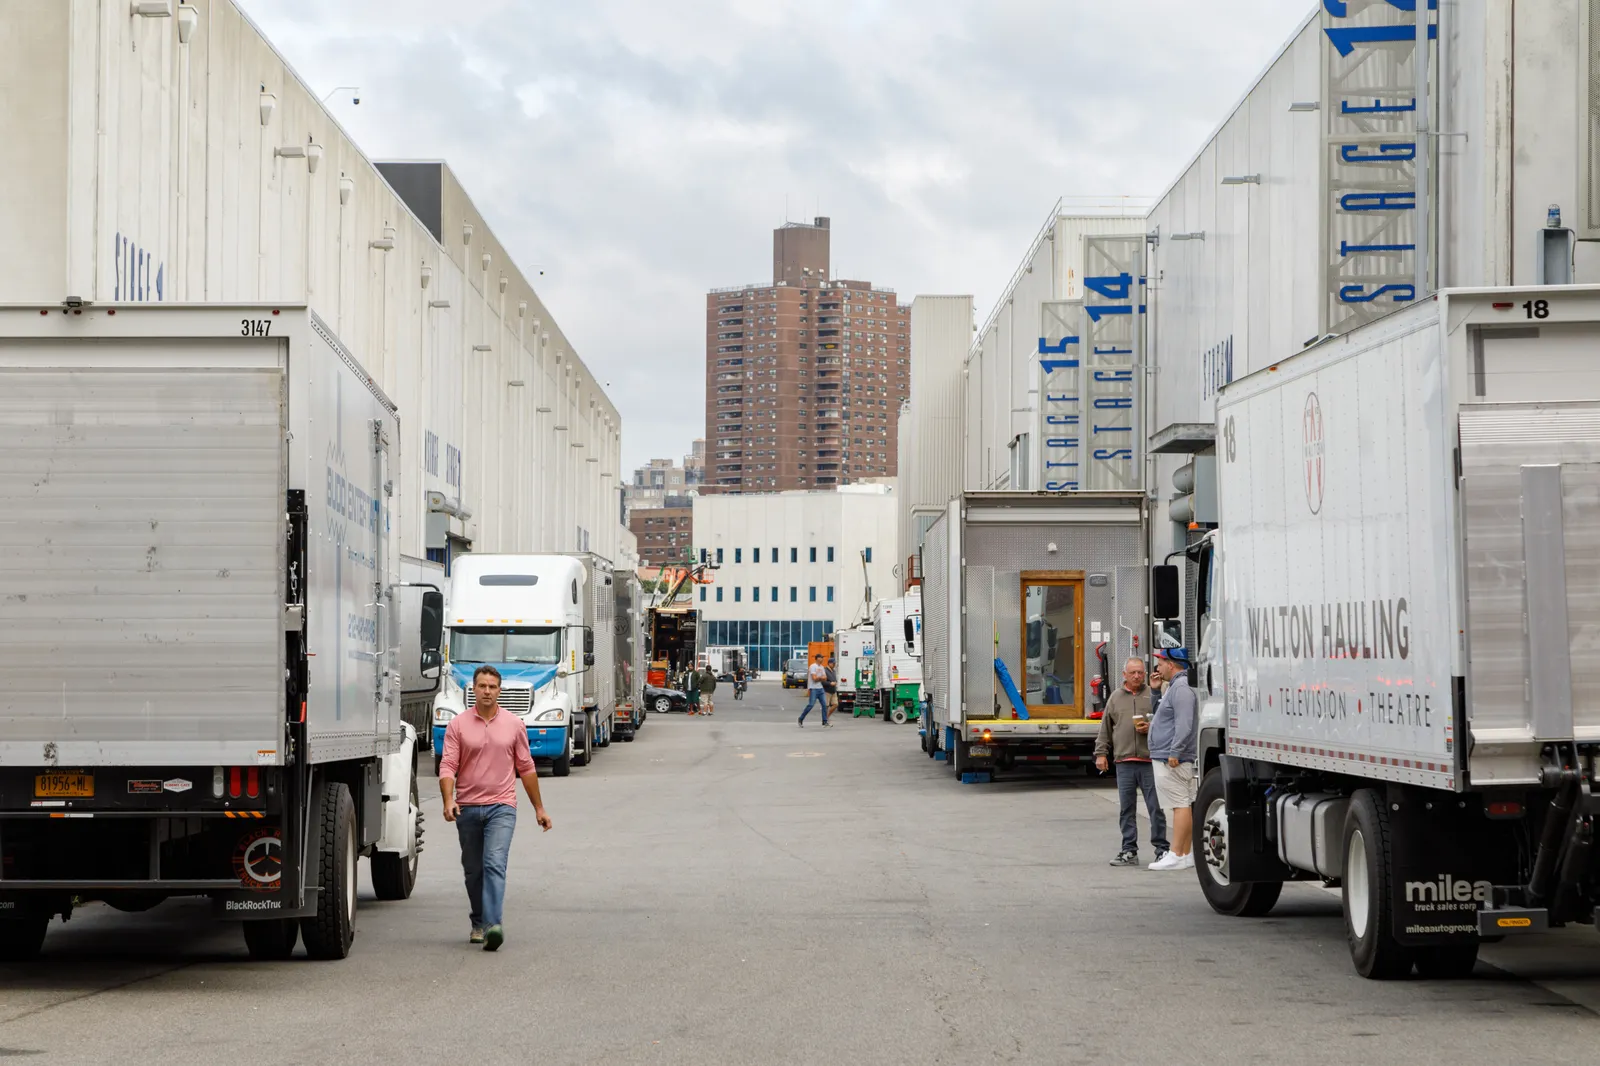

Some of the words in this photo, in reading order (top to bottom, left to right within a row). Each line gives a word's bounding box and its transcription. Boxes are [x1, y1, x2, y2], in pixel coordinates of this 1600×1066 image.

[1340, 97, 1416, 302] STAGE
[1083, 272, 1147, 323] 14
[1522, 299, 1550, 319] 18
[241, 319, 272, 337] 3147
[1038, 335, 1080, 375] 15
[1093, 346, 1133, 461] STAGE
[1046, 394, 1079, 491] STAGE
[1223, 414, 1237, 464] 18
[1247, 604, 1314, 659] WALTON
[1321, 597, 1410, 660] HAULING
[1279, 687, 1347, 720] TELEVISION
[1369, 692, 1432, 728] THEATRE
[1405, 874, 1492, 902] milea
[1414, 902, 1435, 911] truck
[1437, 902, 1458, 911] sales
[1460, 903, 1477, 911] corp
